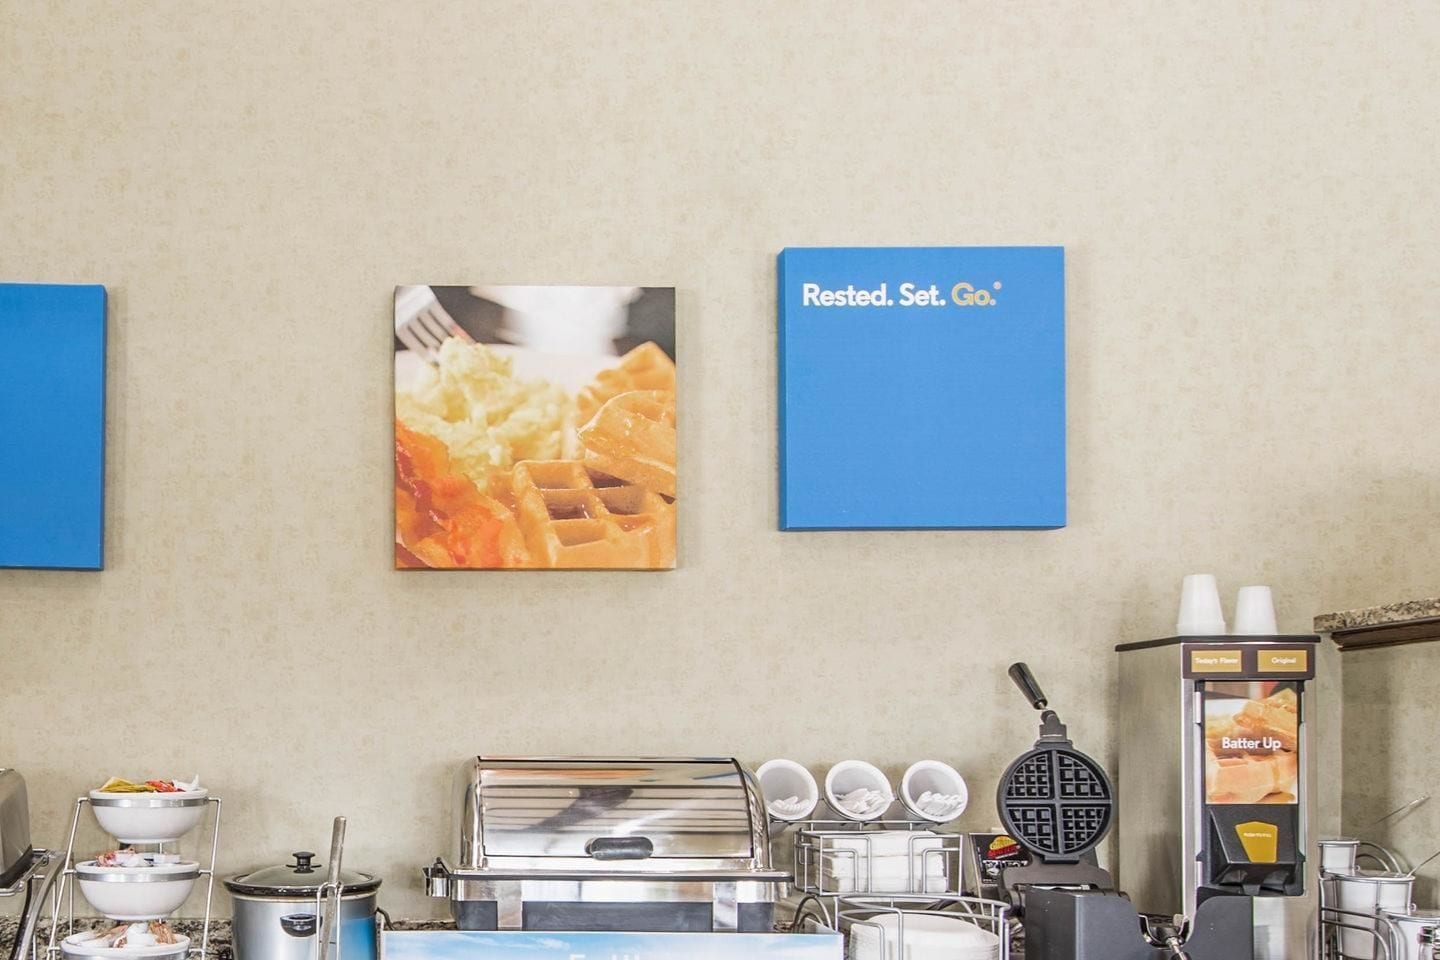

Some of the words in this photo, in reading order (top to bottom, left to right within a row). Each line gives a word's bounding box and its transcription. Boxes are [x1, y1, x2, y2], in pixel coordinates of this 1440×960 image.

[802, 282, 894, 307] Rested.
[898, 282, 947, 307] Set.
[1195, 656, 1218, 665] Today's
[1271, 656, 1297, 665] Original
[1221, 736, 1261, 749] Batter
[1262, 736, 1282, 752] Up
